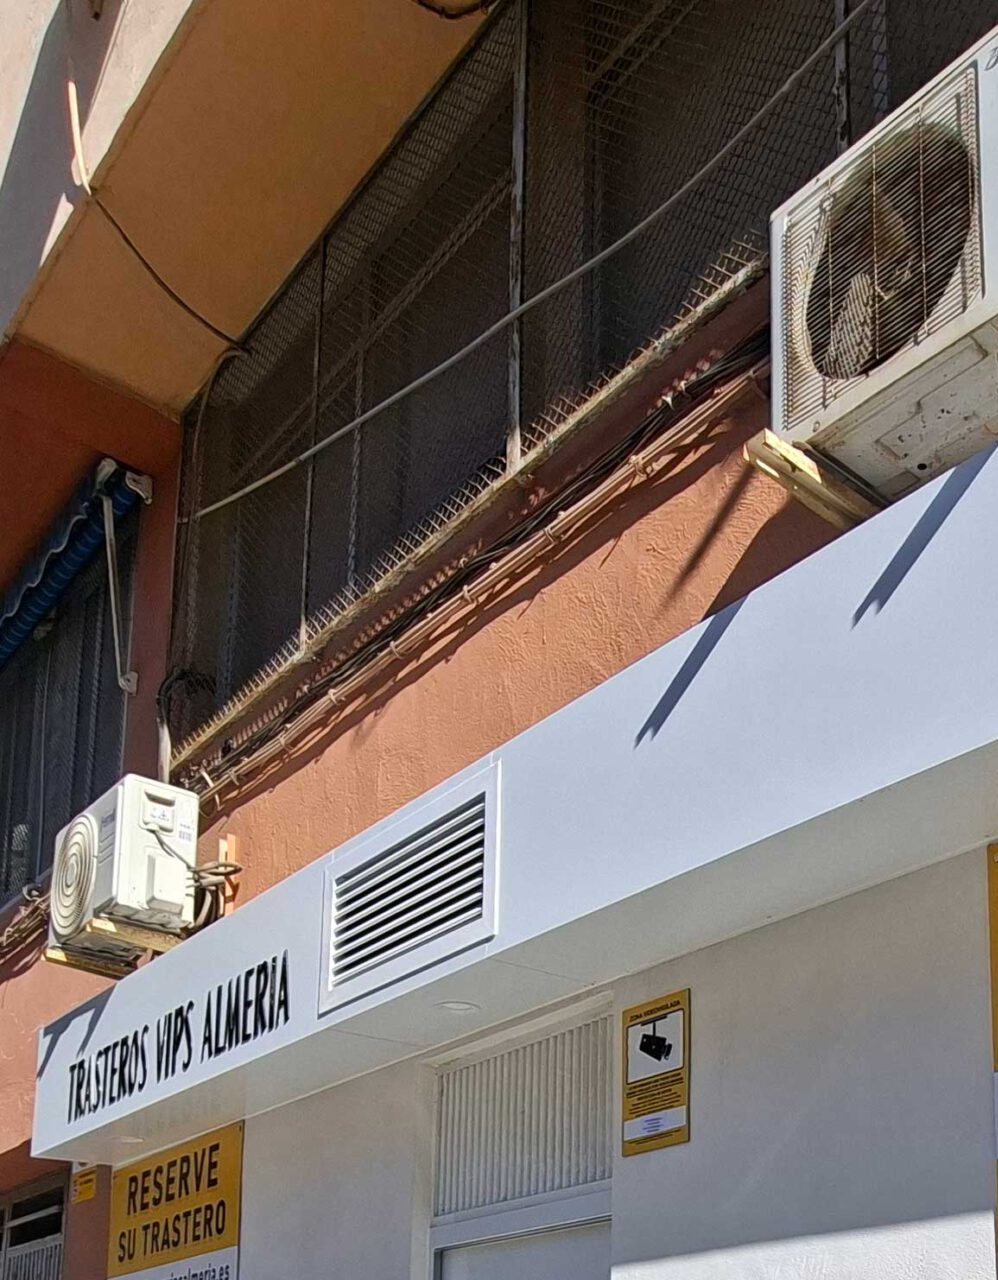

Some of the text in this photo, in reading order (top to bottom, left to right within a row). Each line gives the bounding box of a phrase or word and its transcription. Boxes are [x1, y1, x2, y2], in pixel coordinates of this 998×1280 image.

[68, 1025, 149, 1124] TRASTEROS
[157, 1000, 194, 1084] VIPS
[127, 1143, 220, 1216] RESERVE
[118, 1199, 226, 1262] SU TRASTERO
